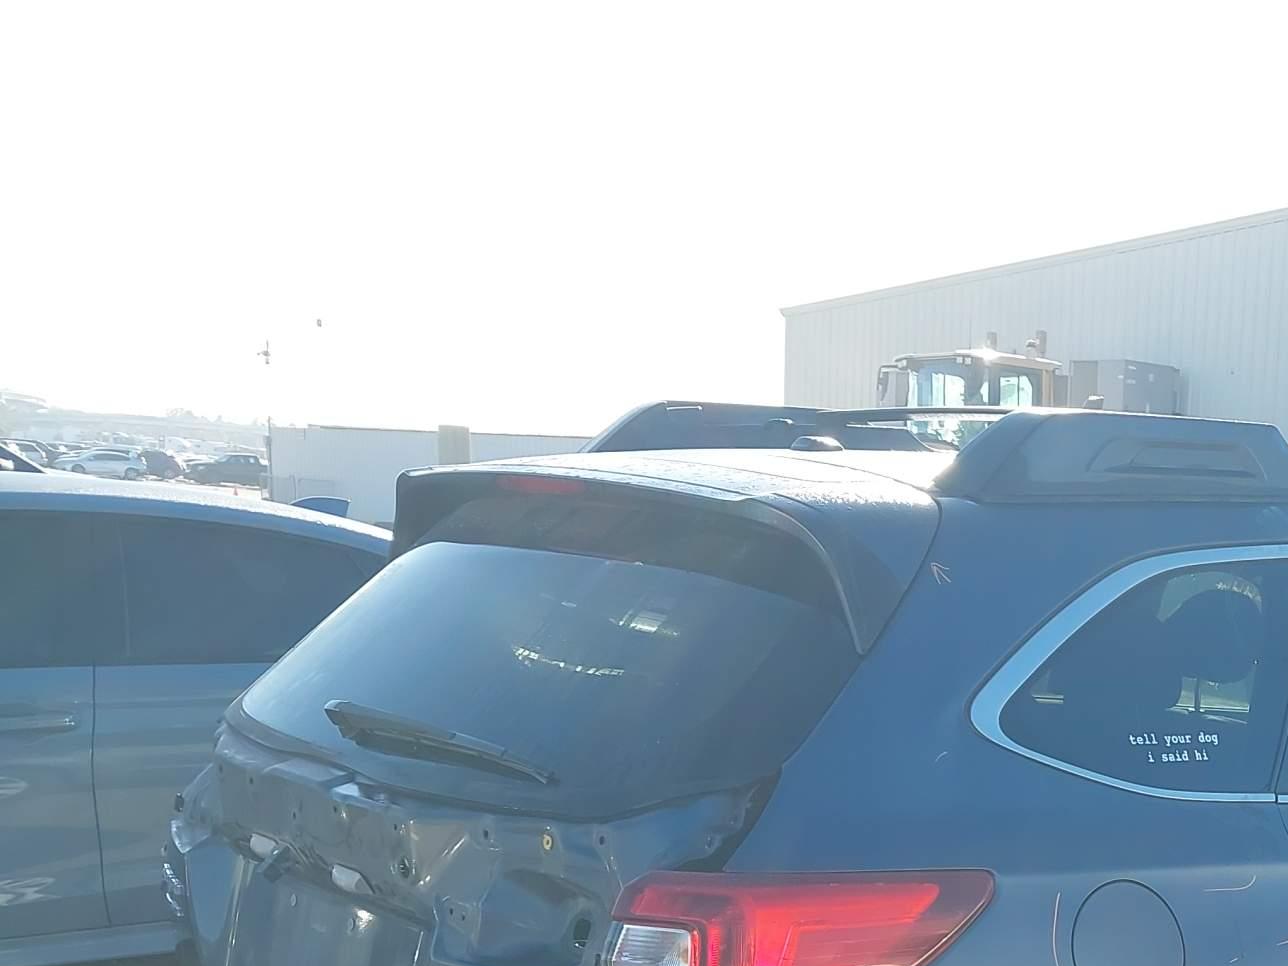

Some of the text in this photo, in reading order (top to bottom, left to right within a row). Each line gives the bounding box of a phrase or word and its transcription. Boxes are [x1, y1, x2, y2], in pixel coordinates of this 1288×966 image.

[1129, 731, 1219, 747] tell your dog
[1147, 748, 1209, 763] i said hi
